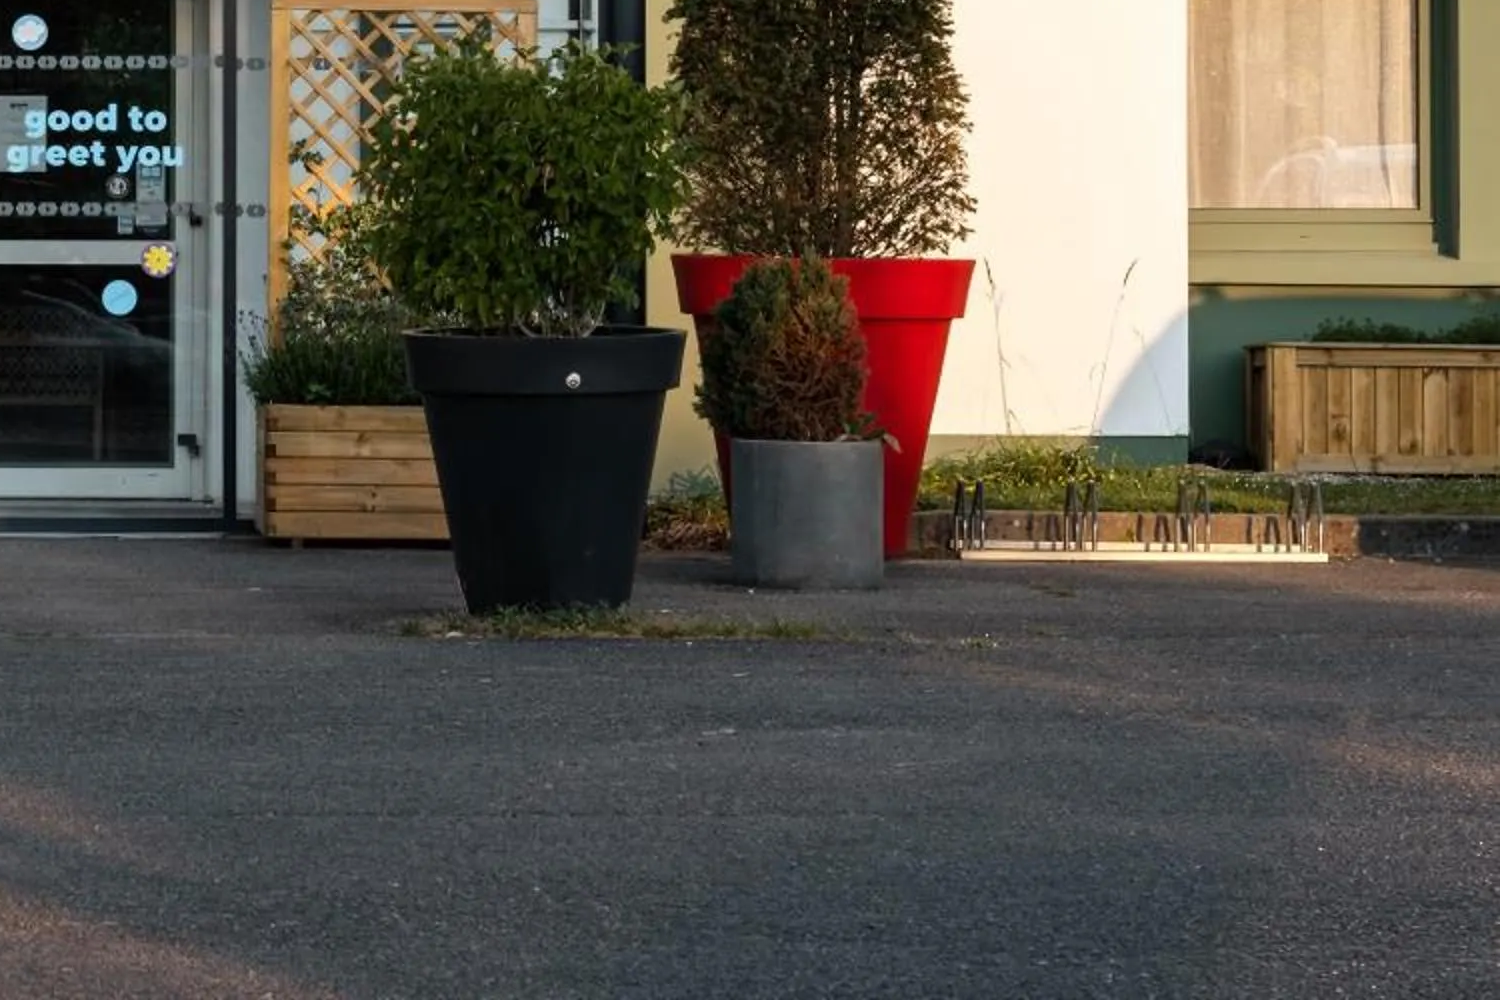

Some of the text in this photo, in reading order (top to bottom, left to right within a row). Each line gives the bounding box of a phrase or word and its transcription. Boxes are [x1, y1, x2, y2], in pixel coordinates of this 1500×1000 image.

[24, 104, 167, 138] good to
[7, 141, 184, 173] greet you
